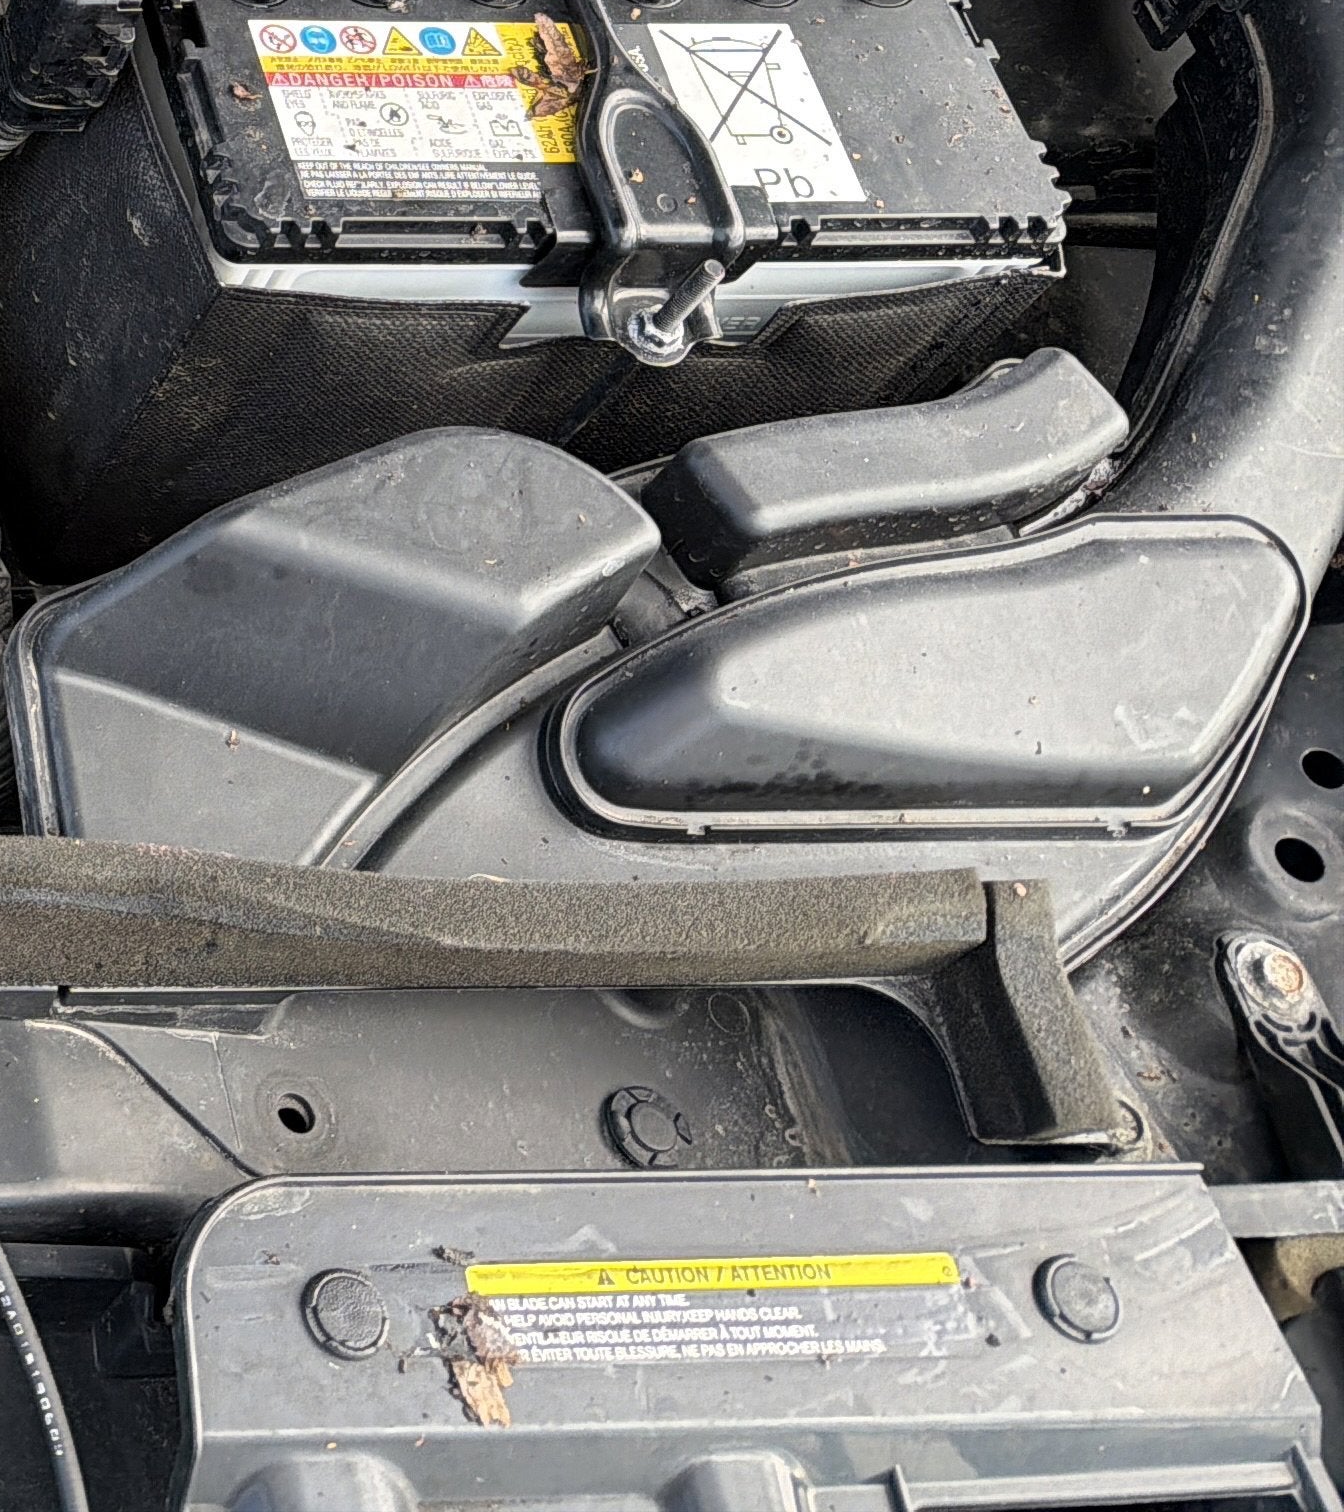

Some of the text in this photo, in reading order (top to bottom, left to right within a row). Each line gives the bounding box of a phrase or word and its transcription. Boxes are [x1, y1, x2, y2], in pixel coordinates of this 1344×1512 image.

[297, 161, 314, 170] KEEP
[315, 161, 328, 170] OUT
[329, 162, 337, 170] OF
[353, 162, 374, 170] REACH
[375, 162, 383, 170] OF
[311, 170, 324, 179] PAS
[325, 171, 352, 179] LAISSER
[424, 182, 436, 190] CAN
[437, 182, 461, 190] RESULT
[754, 167, 814, 198] Pb
[626, 1266, 710, 1285] CAUTION
[731, 1263, 832, 1283] ATTENTION
[507, 1297, 548, 1311] BLADE
[548, 1296, 575, 1310] CAN
[576, 1295, 613, 1309] START
[616, 1295, 631, 1309] AT
[632, 1294, 656, 1308] ANY
[657, 1293, 690, 1307] TIME.
[504, 1313, 536, 1327] HELP
[539, 1312, 575, 1327] AVOID
[576, 1311, 642, 1326] PERSONAL
[715, 1307, 759, 1322] HANDS
[759, 1306, 802, 1320] CLEAR.
[585, 1329, 633, 1344] RISQUE
[633, 1328, 652, 1343] DE
[652, 1325, 718, 1342] DÉMARRER
[719, 1323, 730, 1340] À
[729, 1325, 760, 1340] TOUT
[762, 1324, 819, 1339] MOMENT.
[530, 1345, 572, 1362] ÉVITER
[573, 1346, 614, 1361] TOUTE
[681, 1344, 701, 1358] NE
[701, 1343, 725, 1358] PAS
[726, 1342, 745, 1357] EN
[746, 1341, 820, 1356] APPROCHER
[821, 1339, 844, 1355] LES
[845, 1338, 887, 1354] MAINS.
